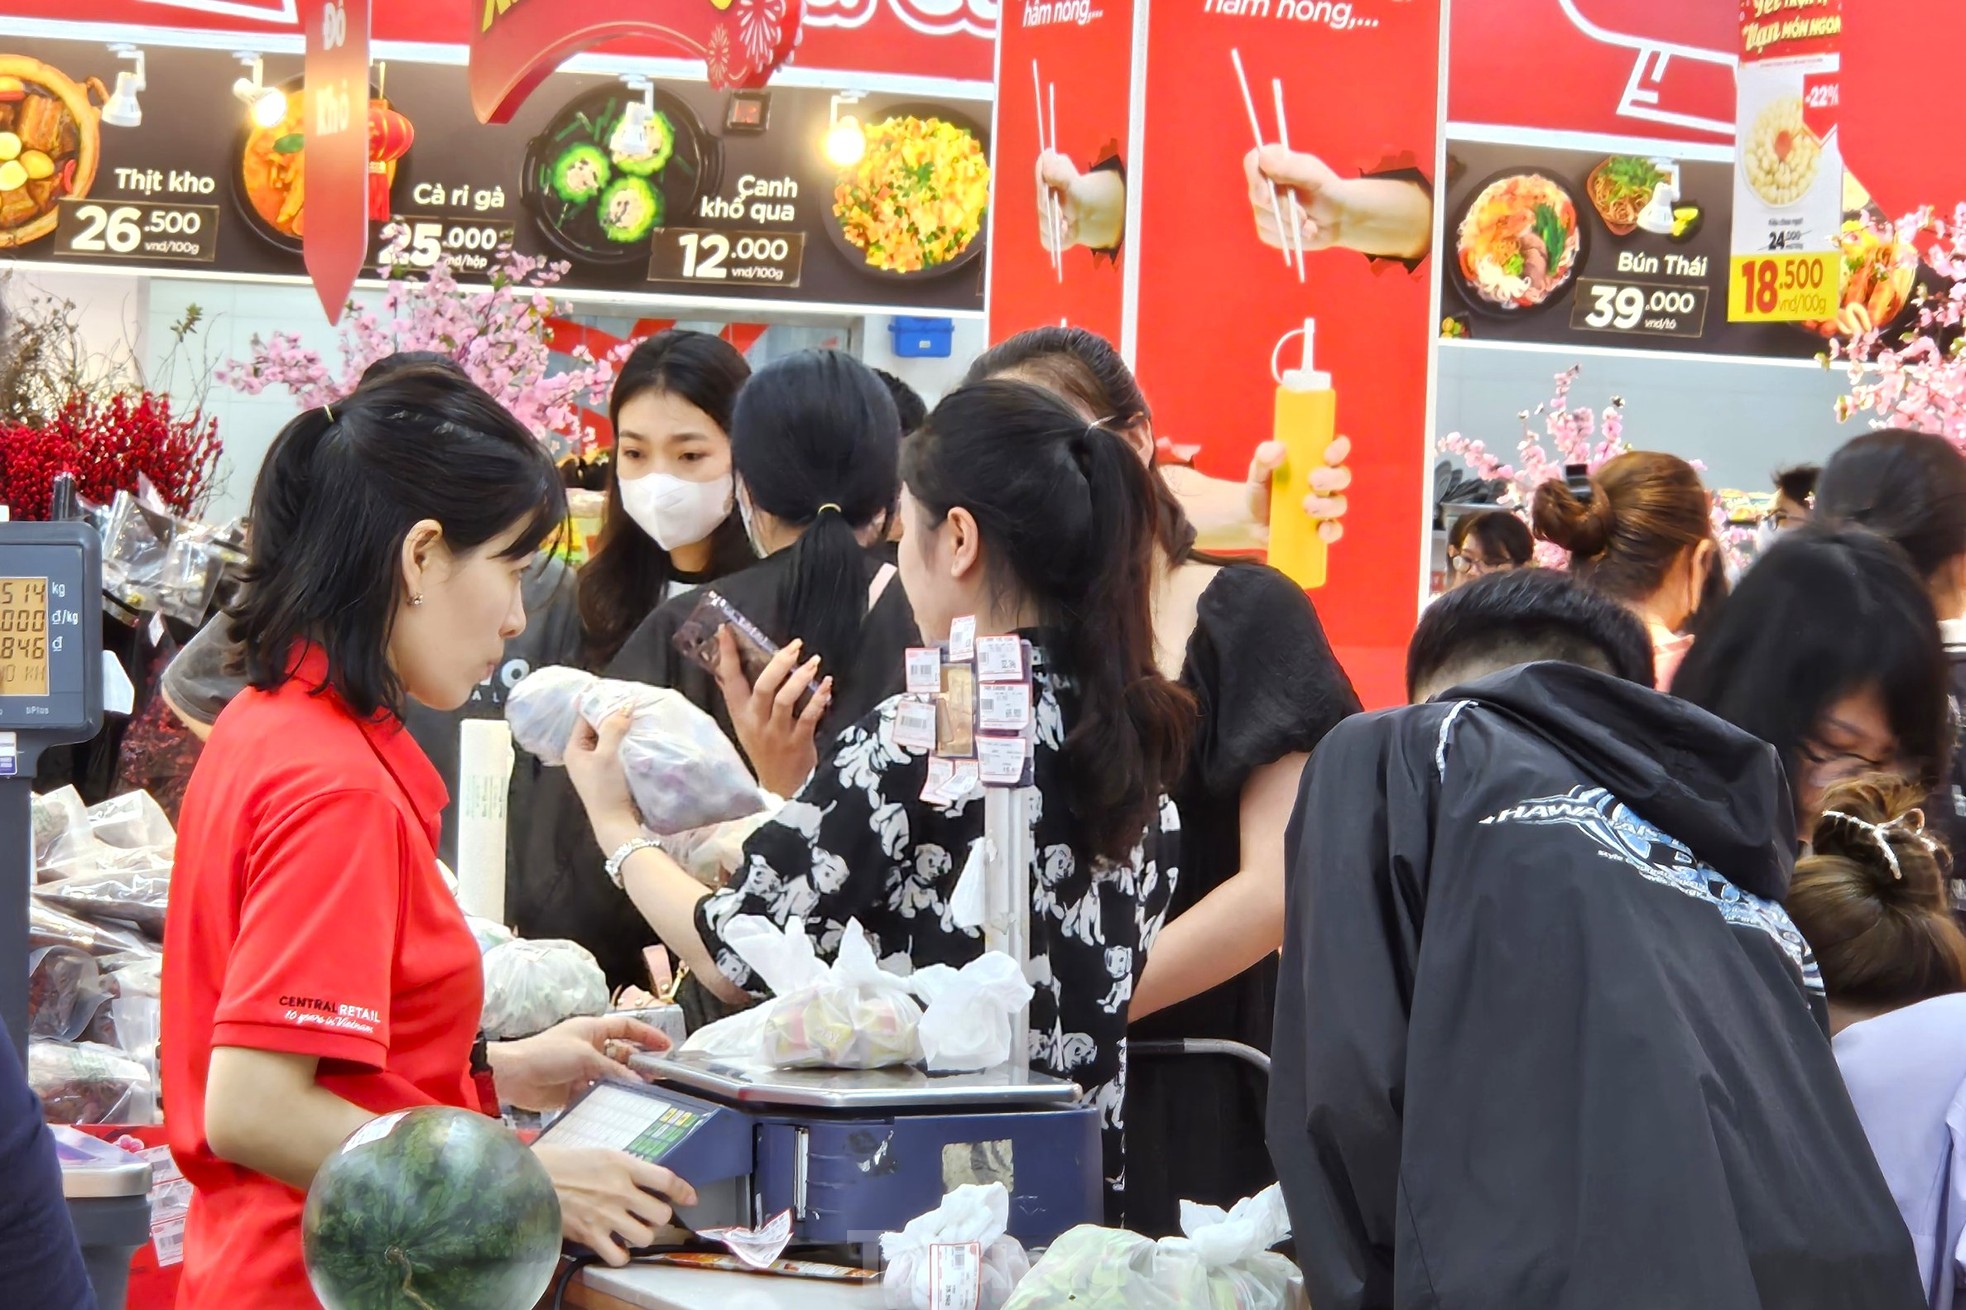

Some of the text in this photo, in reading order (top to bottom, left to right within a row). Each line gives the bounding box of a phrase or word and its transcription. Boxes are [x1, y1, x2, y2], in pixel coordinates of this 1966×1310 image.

[114, 167, 216, 195] Thịt kho
[738, 174, 798, 198] Canh
[413, 182, 505, 210] Cà ri gà
[750, 202, 795, 223] qua
[1617, 251, 1708, 276] Bún Thái
[52, 581, 66, 598] kg
[279, 995, 381, 1023] CENTRAL RETAIL
